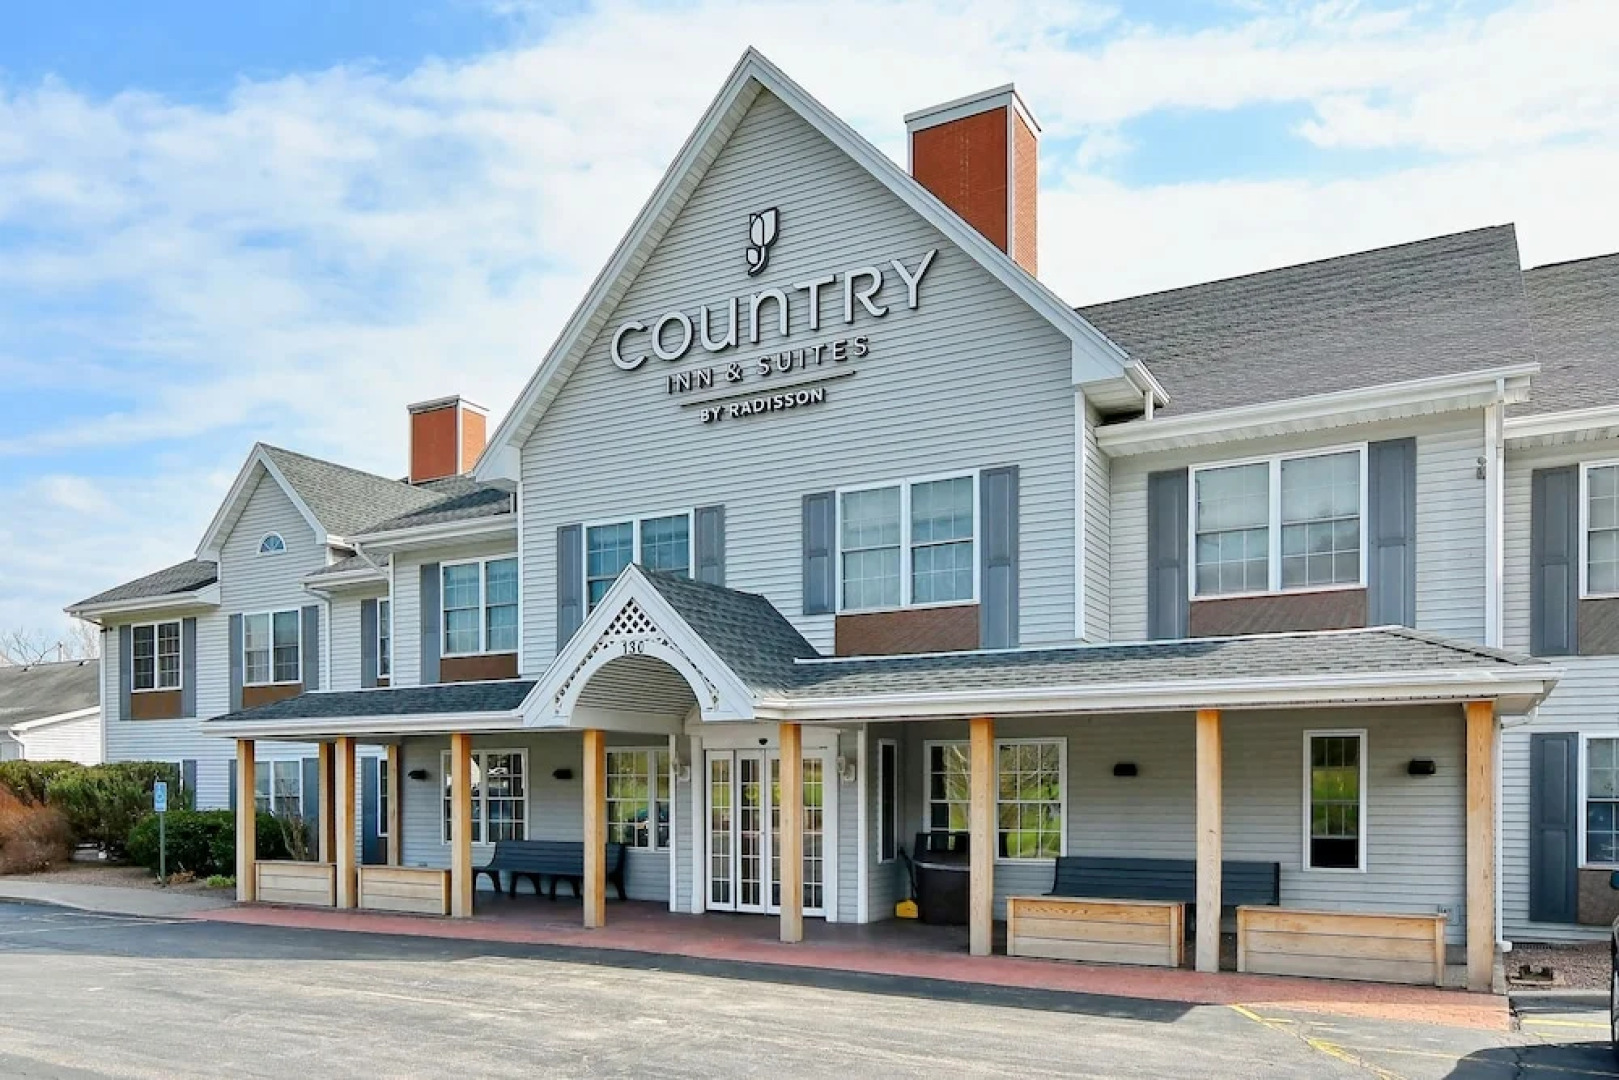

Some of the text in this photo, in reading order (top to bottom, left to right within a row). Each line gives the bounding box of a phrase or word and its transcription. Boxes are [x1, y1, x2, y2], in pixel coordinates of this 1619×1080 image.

[666, 335, 870, 394] INN & SUITES
[700, 388, 826, 423] BY RADISSON
